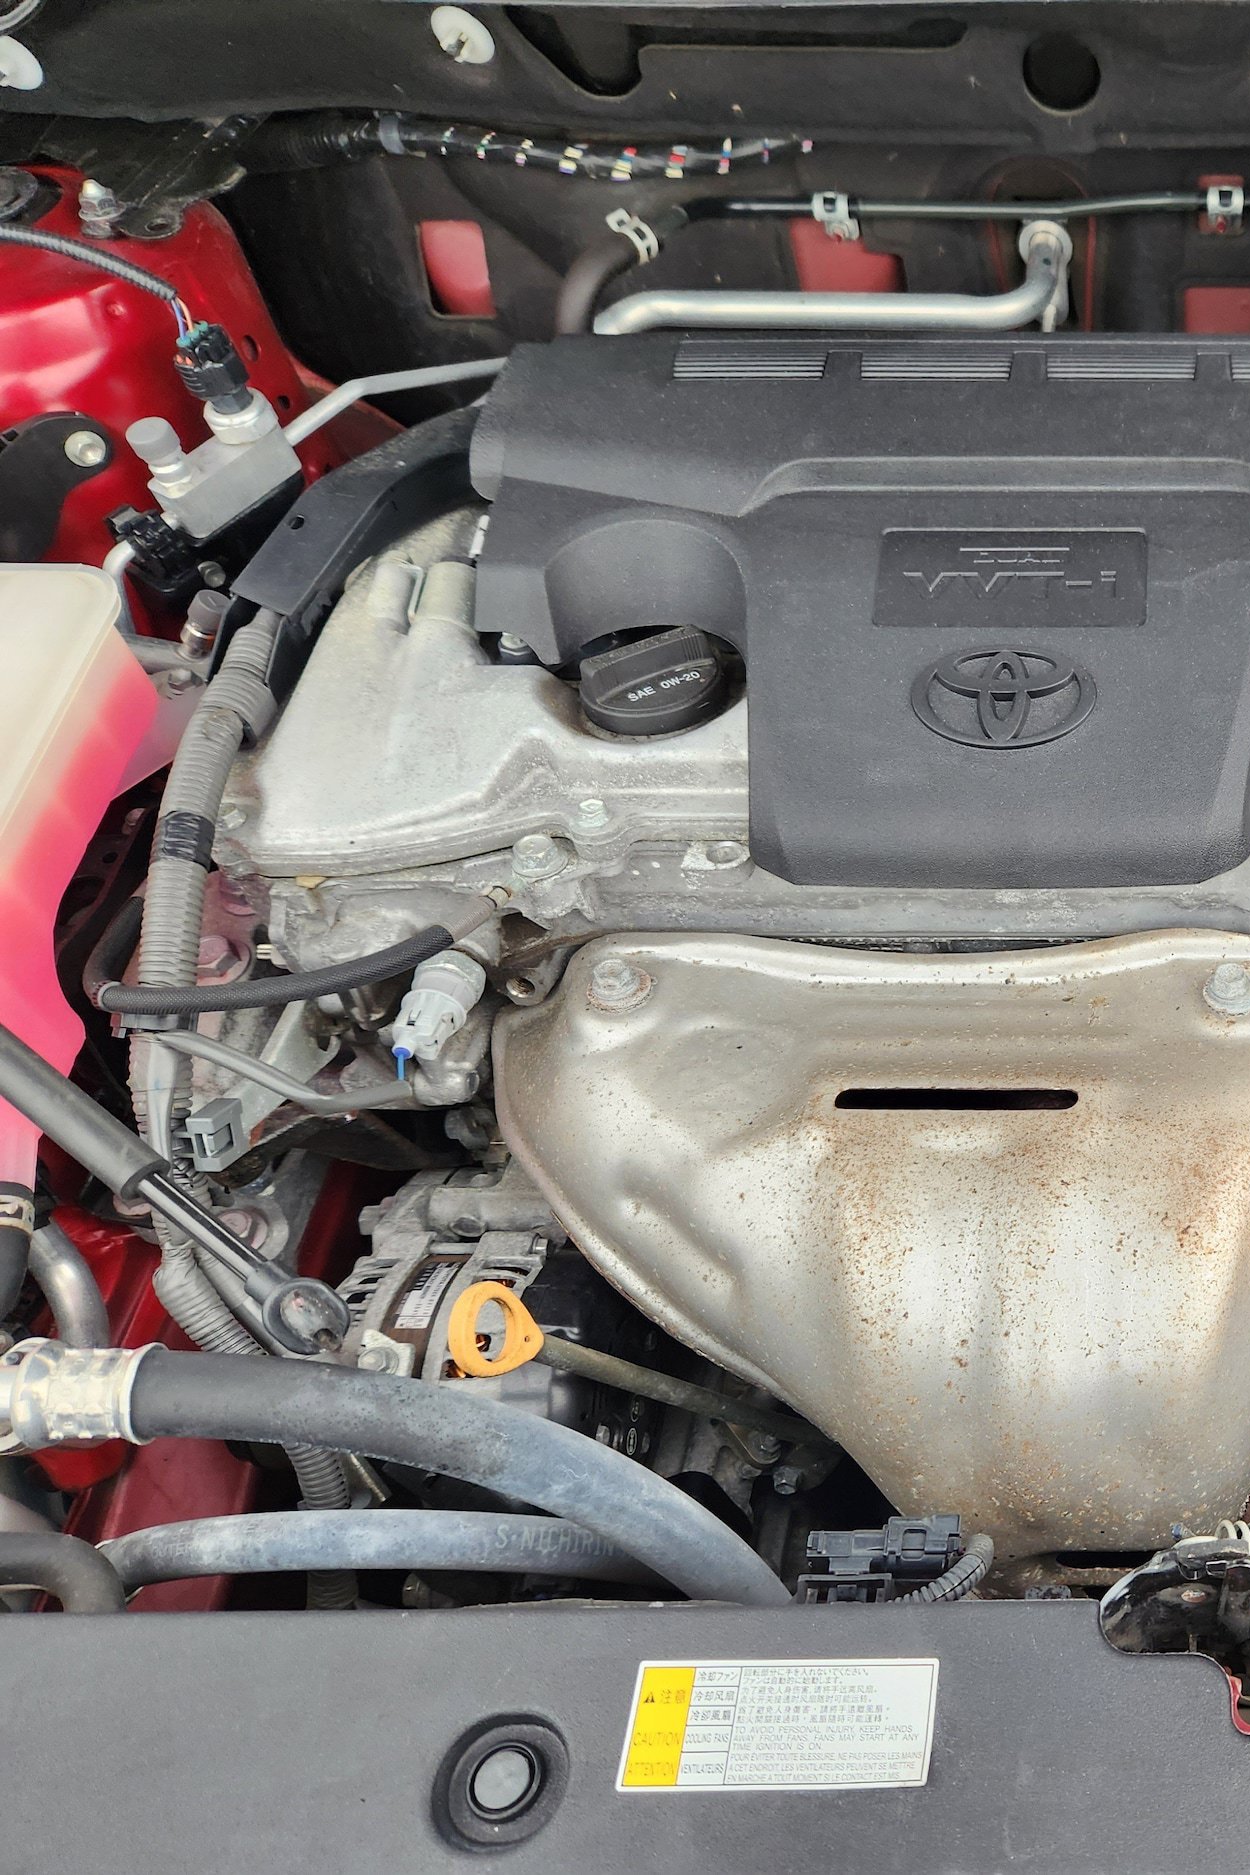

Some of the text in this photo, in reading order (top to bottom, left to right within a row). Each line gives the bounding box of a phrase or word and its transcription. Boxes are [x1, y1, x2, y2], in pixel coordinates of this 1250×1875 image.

[627, 670, 700, 702] SAE 0W-20
[698, 1670, 739, 1682] 冷却ファン
[735, 1726, 746, 1734] TO
[860, 1725, 880, 1733] KEEP
[633, 1731, 681, 1746] CAUTION
[685, 1733, 730, 1744] COOLING FANS
[729, 1753, 749, 1761] POUR
[863, 1752, 886, 1760] POSER
[628, 1761, 675, 1776] ATTENTION
[680, 1763, 725, 1774] VENTILATEURS
[781, 1763, 794, 1771] LES
[795, 1763, 845, 1771] VENTILATEURS
[879, 1762, 887, 1770] SE
[738, 1774, 766, 1782] MARCHE
[832, 1773, 841, 1781] LE
[842, 1773, 872, 1781] CONTACT
[874, 1772, 887, 1780] EST
